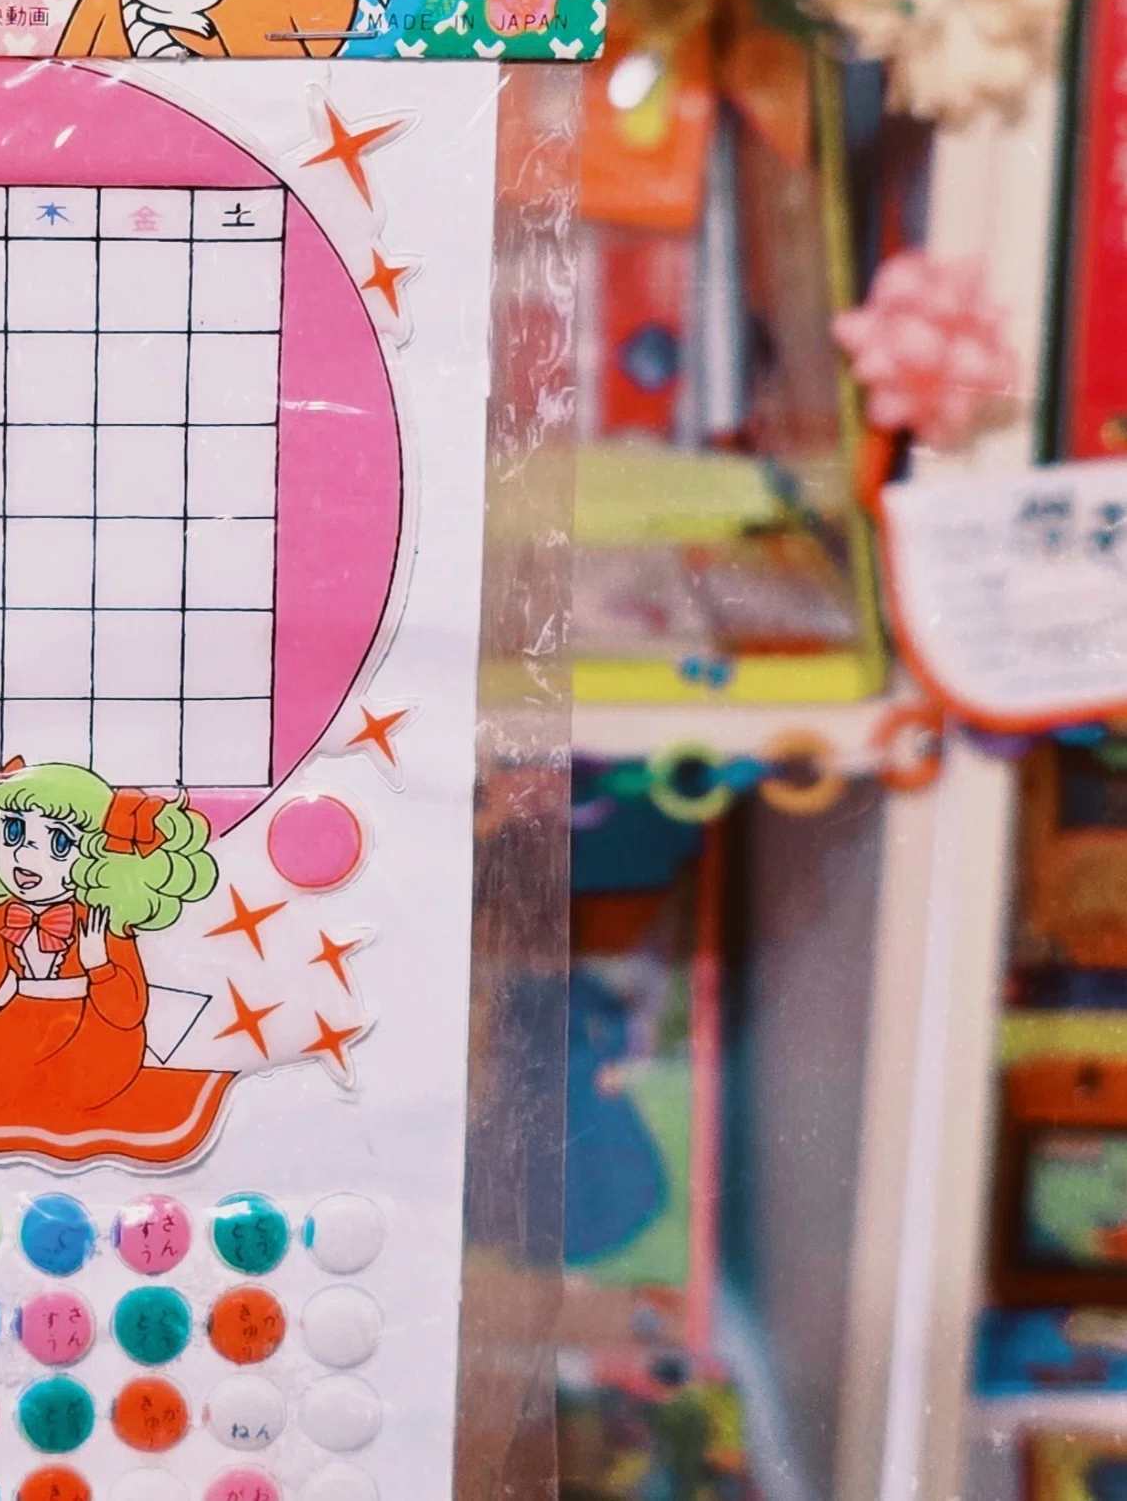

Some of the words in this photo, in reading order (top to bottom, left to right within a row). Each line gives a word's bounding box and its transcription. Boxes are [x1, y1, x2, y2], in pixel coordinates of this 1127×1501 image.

[367, 13, 432, 30] MADE
[454, 14, 474, 29] IN
[497, 13, 568, 31] JAPAN
[36, 202, 70, 225] 木
[129, 205, 163, 231] 金
[222, 202, 255, 227] 土
